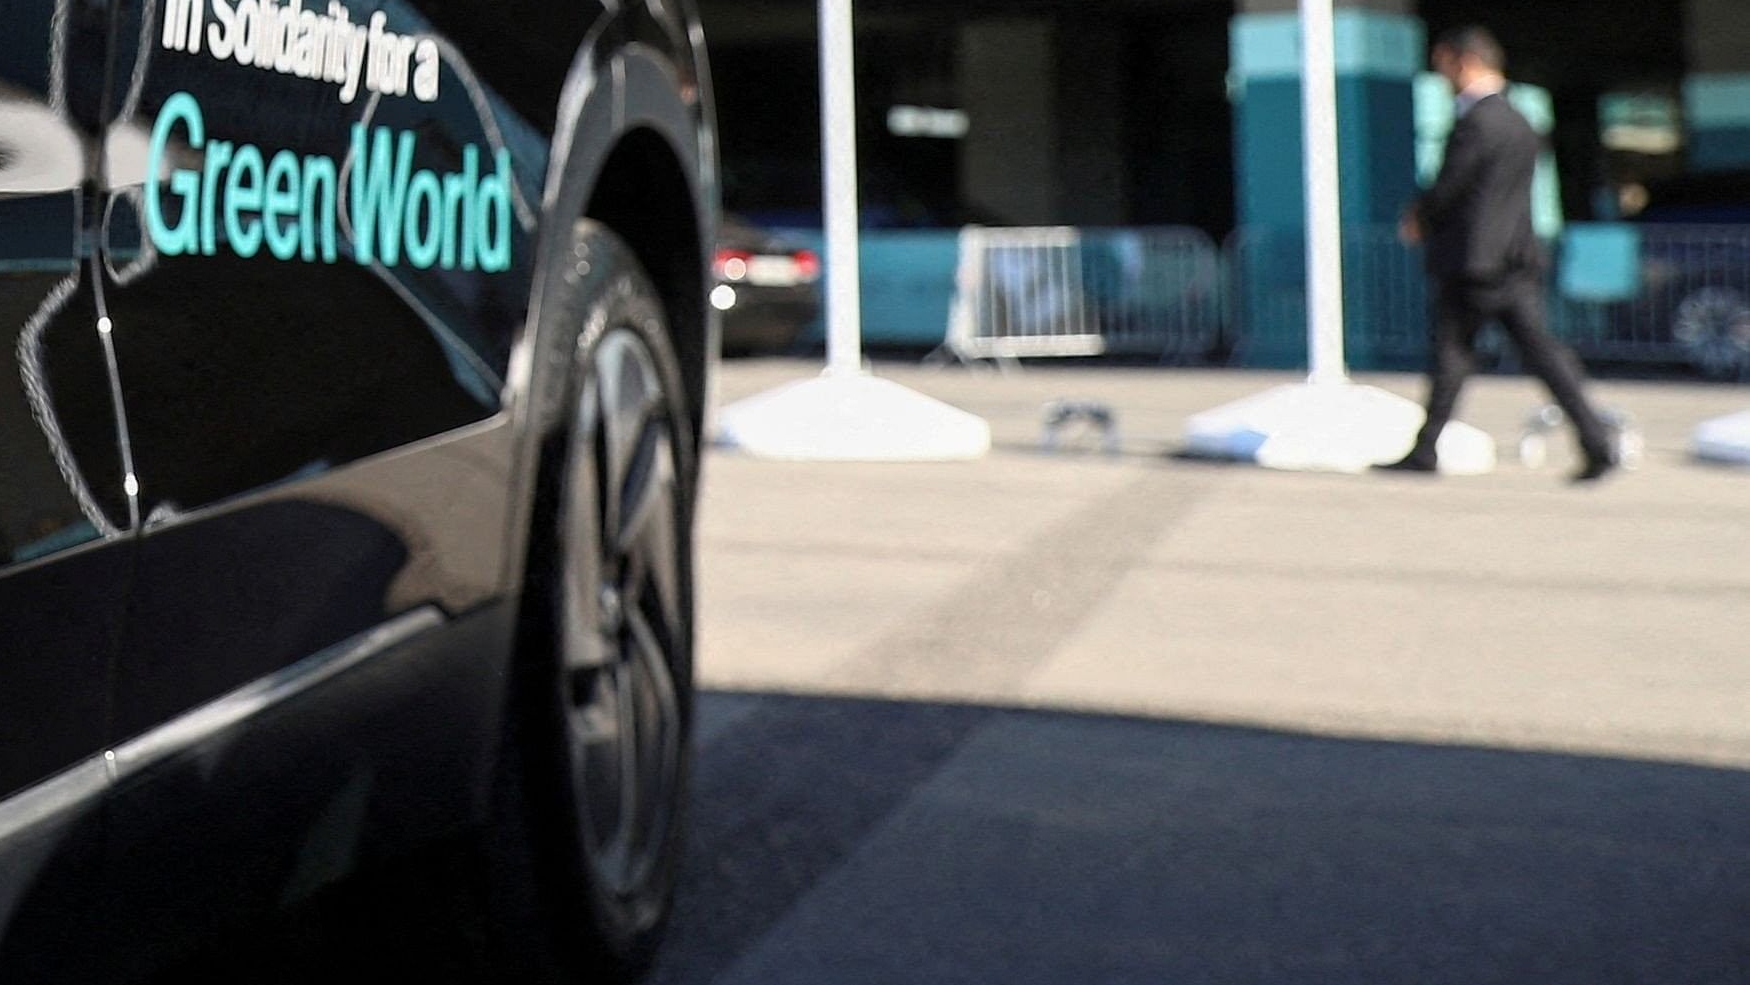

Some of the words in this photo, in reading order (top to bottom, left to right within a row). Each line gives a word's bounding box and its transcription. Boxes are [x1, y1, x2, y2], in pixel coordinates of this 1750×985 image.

[366, 11, 415, 97] for
[413, 38, 439, 102] a
[145, 91, 338, 264] Green
[352, 122, 511, 272] World
